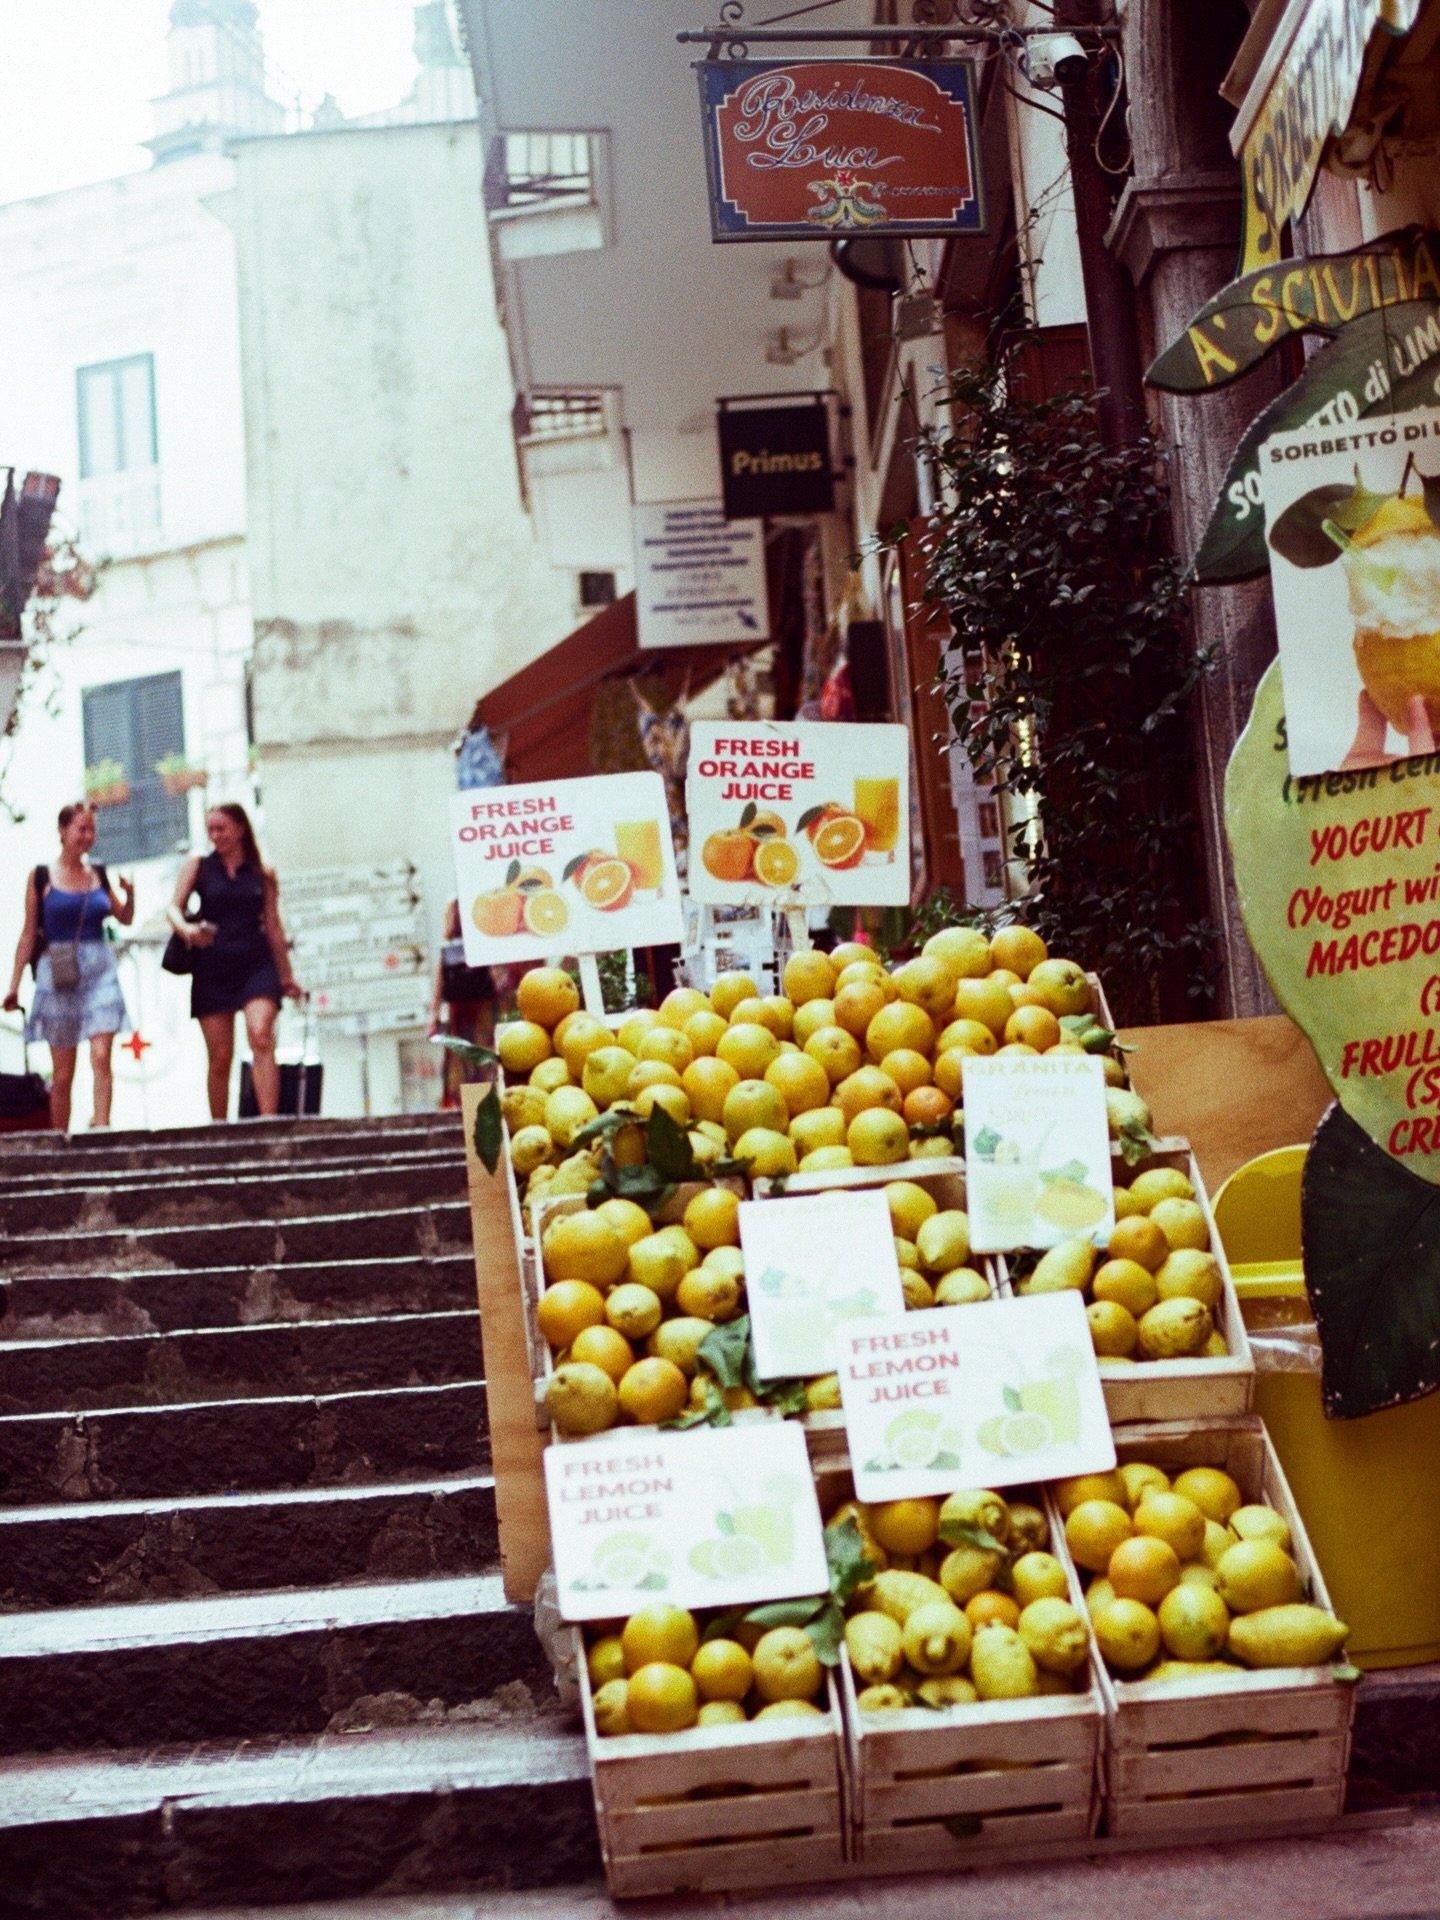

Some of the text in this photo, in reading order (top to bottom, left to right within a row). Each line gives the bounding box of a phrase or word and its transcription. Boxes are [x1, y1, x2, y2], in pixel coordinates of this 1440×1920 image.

[734, 76, 941, 140] Residenza
[747, 114, 904, 169] Luce
[1365, 359, 1390, 402] di
[1270, 429, 1397, 463] SORBETTO
[1404, 423, 1427, 441] DI
[733, 447, 822, 474] Primus
[714, 739, 799, 757] FRESH
[699, 760, 815, 779] ORANGE
[721, 783, 792, 801] JUICE
[471, 798, 556, 820] FRESH
[458, 816, 575, 843] ORANGE
[1310, 807, 1432, 866] YOGURT
[484, 838, 555, 860] JUICE
[1287, 877, 1397, 930] (Yogurt
[1306, 919, 1440, 979] MACEDO
[851, 1329, 949, 1354] FRESH
[849, 1352, 960, 1380] LEMON
[868, 1378, 950, 1403] JUICE
[564, 1455, 664, 1477] FRESH
[559, 1478, 673, 1502] LEMON
[579, 1502, 661, 1525] JUICE
